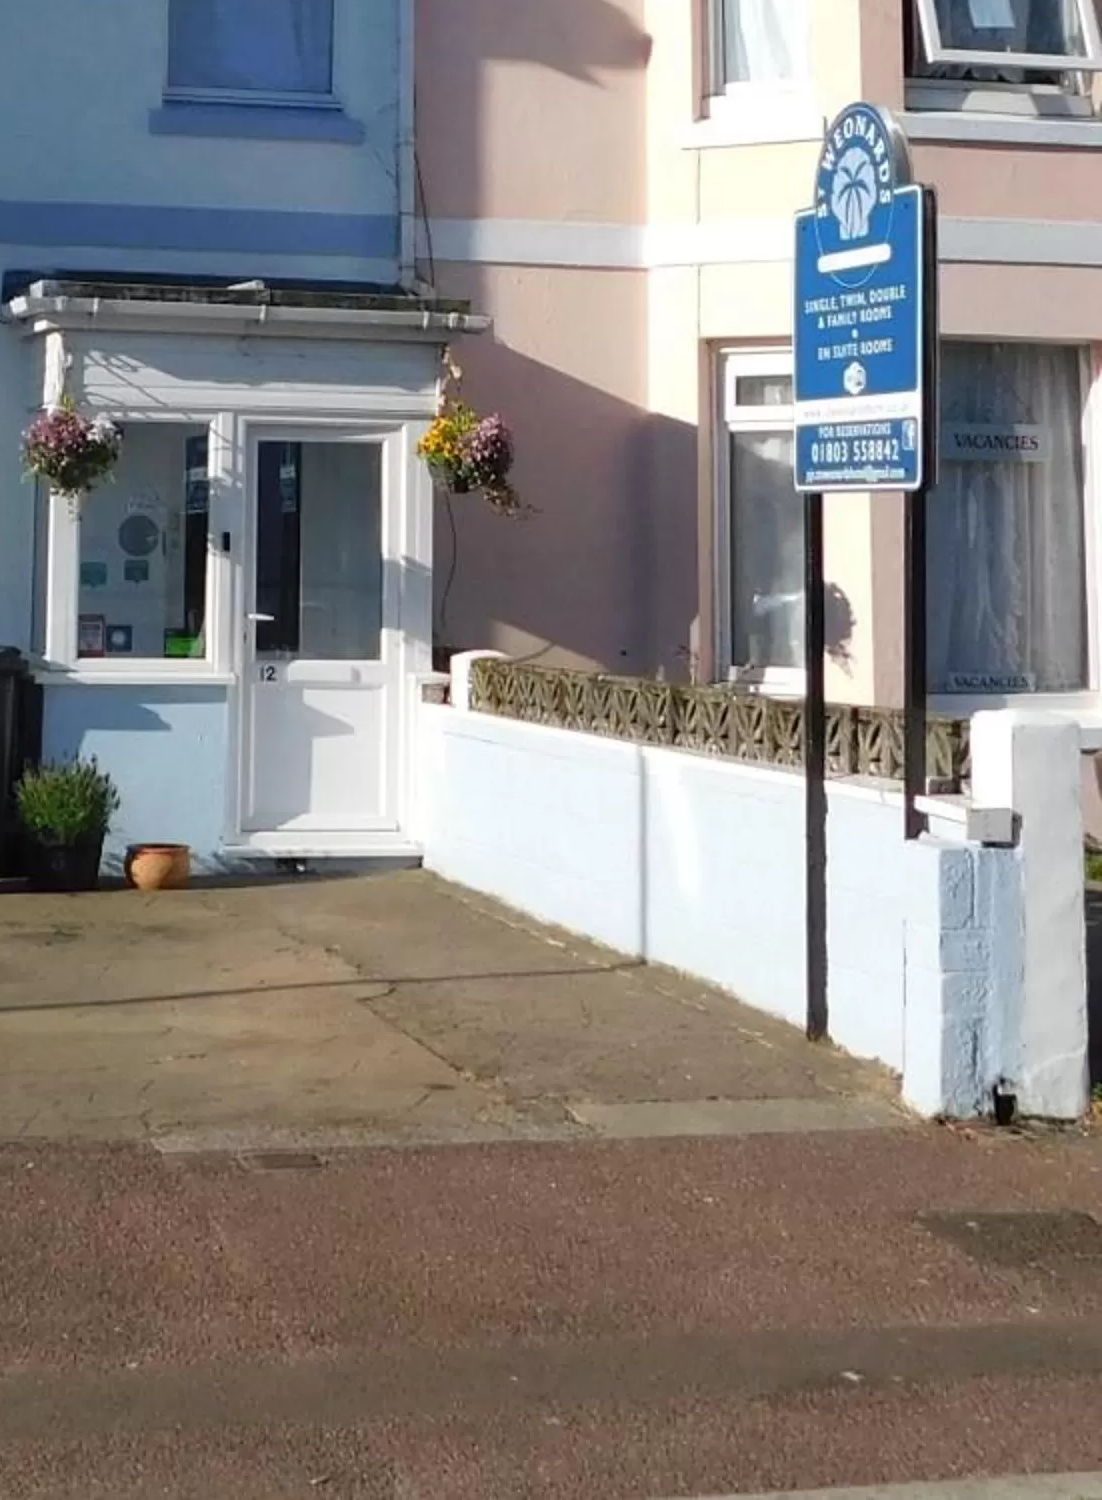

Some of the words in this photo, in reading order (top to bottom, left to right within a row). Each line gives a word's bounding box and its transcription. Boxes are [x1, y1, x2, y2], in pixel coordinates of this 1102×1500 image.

[869, 284, 907, 304] DOUBLE
[827, 311, 857, 329] FAMILY
[859, 305, 893, 323] ROOMS
[818, 347, 831, 361] EN
[832, 342, 858, 360] SUITE
[860, 338, 894, 355] ROOMS
[818, 425, 835, 439] FOR
[836, 421, 892, 437] RESERVATIONS
[811, 441, 849, 463] 01803
[853, 438, 900, 462] 558842
[953, 432, 1040, 451] VACANCIES
[259, 664, 277, 682] 12
